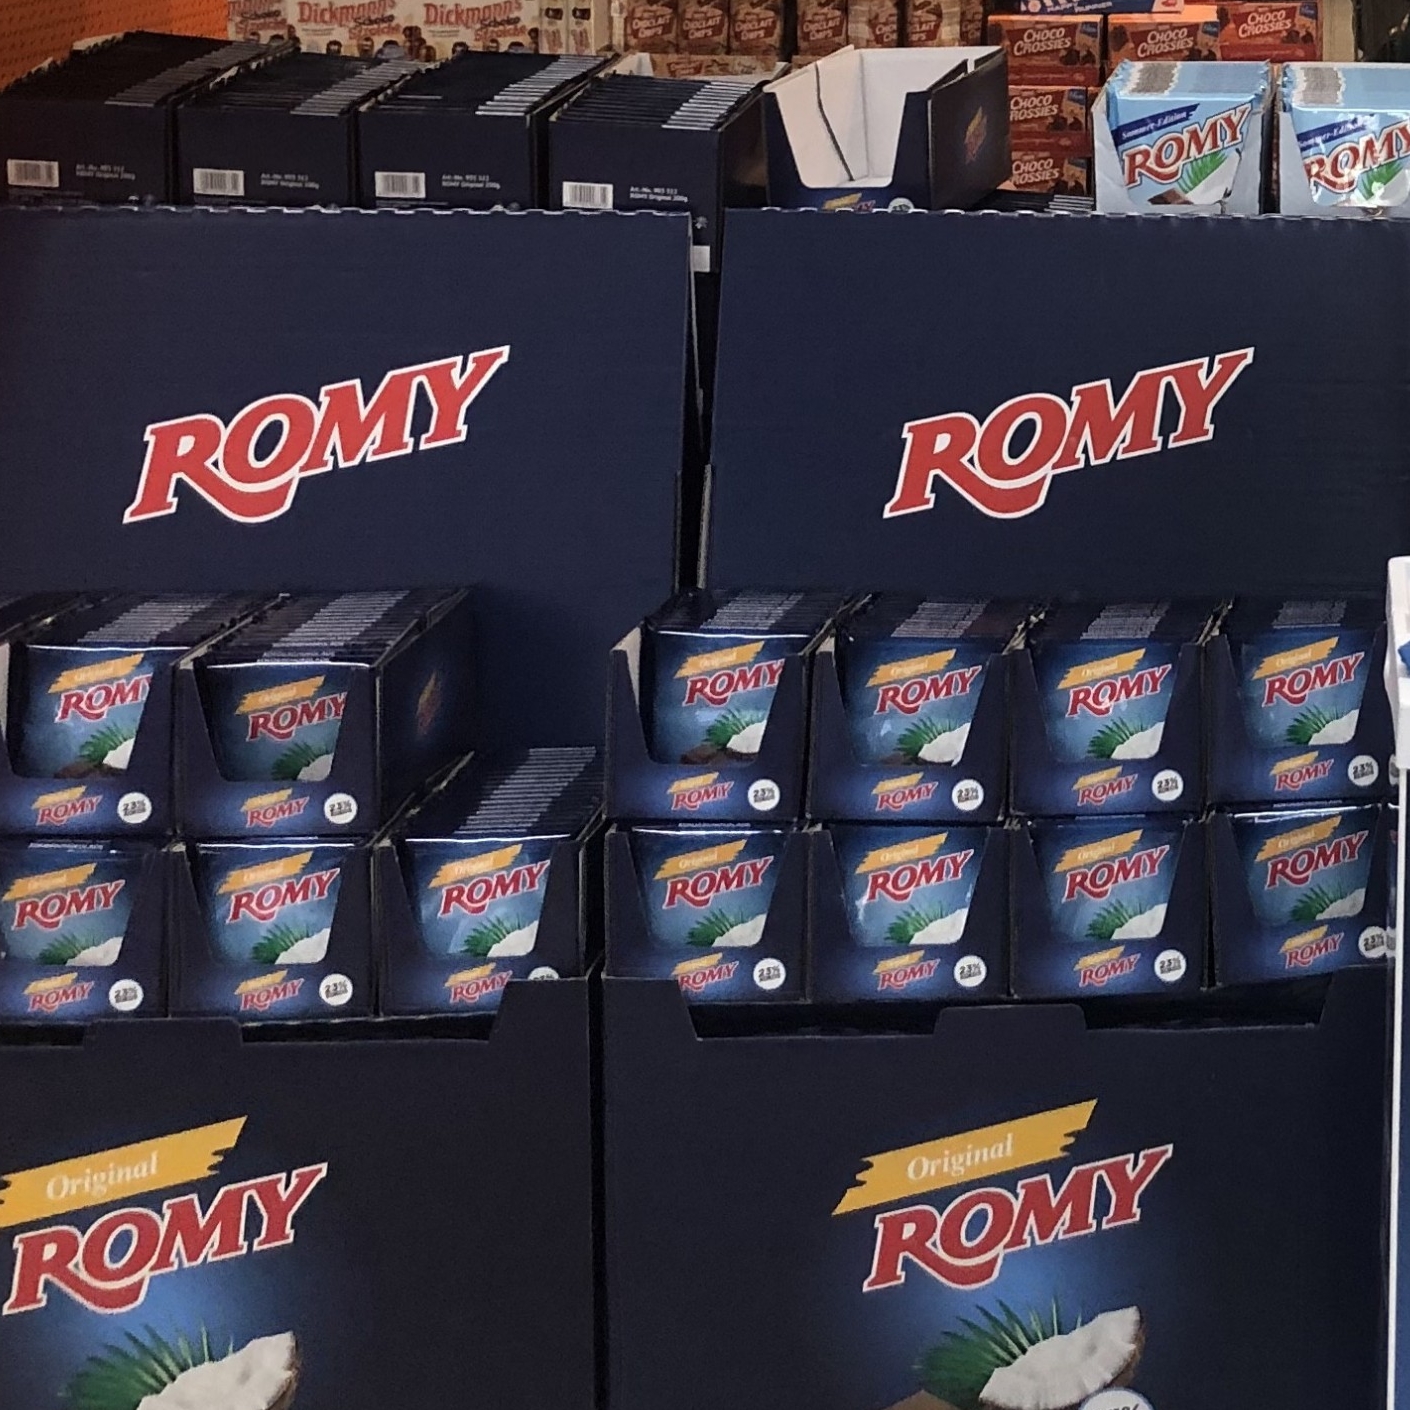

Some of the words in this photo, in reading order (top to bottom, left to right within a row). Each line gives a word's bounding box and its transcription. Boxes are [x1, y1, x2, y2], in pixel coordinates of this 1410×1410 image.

[1238, 18, 1292, 39] CROSSIES
[1247, 9, 1286, 25] CHOCO
[1013, 37, 1071, 55] CROSSIES
[1023, 27, 1065, 42] CHOCO
[1137, 38, 1194, 58] CROSSIES
[1146, 27, 1188, 44] CHOCO
[1009, 105, 1058, 122] ROSSIES
[1010, 94, 1052, 110] CHOCO
[1122, 102, 1251, 190] ROMY
[1011, 167, 1060, 185] ROSSIES
[1012, 158, 1053, 175] CHOCO
[123, 345, 510, 524] ROMY
[883, 347, 1255, 519] ROMY
[683, 659, 785, 707] ROMY
[874, 665, 982, 716] ROMY
[1066, 664, 1172, 718] ROMY
[1262, 652, 1365, 707] ROMY
[246, 692, 348, 743] ROMY
[1077, 774, 1138, 806] ROMY
[1275, 760, 1334, 791] ROMY
[37, 795, 102, 827] ROMY
[246, 797, 309, 828] ROMY
[672, 781, 734, 811] ROMY
[876, 781, 939, 812] ROMY
[865, 849, 974, 903] ROMY
[1062, 845, 1170, 903] ROMY
[1264, 830, 1369, 890] ROMY
[227, 867, 340, 925] ROMY
[438, 859, 551, 919] ROMY
[663, 855, 774, 911] ROMY
[13, 879, 125, 930] ROMY
[1286, 933, 1345, 969] ROMY
[450, 970, 512, 1004] ROMY
[679, 961, 739, 992] ROMY
[878, 958, 940, 991] ROMY
[1079, 954, 1141, 987] ROMY
[28, 981, 94, 1012] ROMY
[241, 978, 304, 1011] ROMY
[907, 1133, 1014, 1181] Original
[46, 1153, 158, 1201] Original
[862, 1143, 1173, 1292] ROMY
[2, 1161, 329, 1315] ROMY
